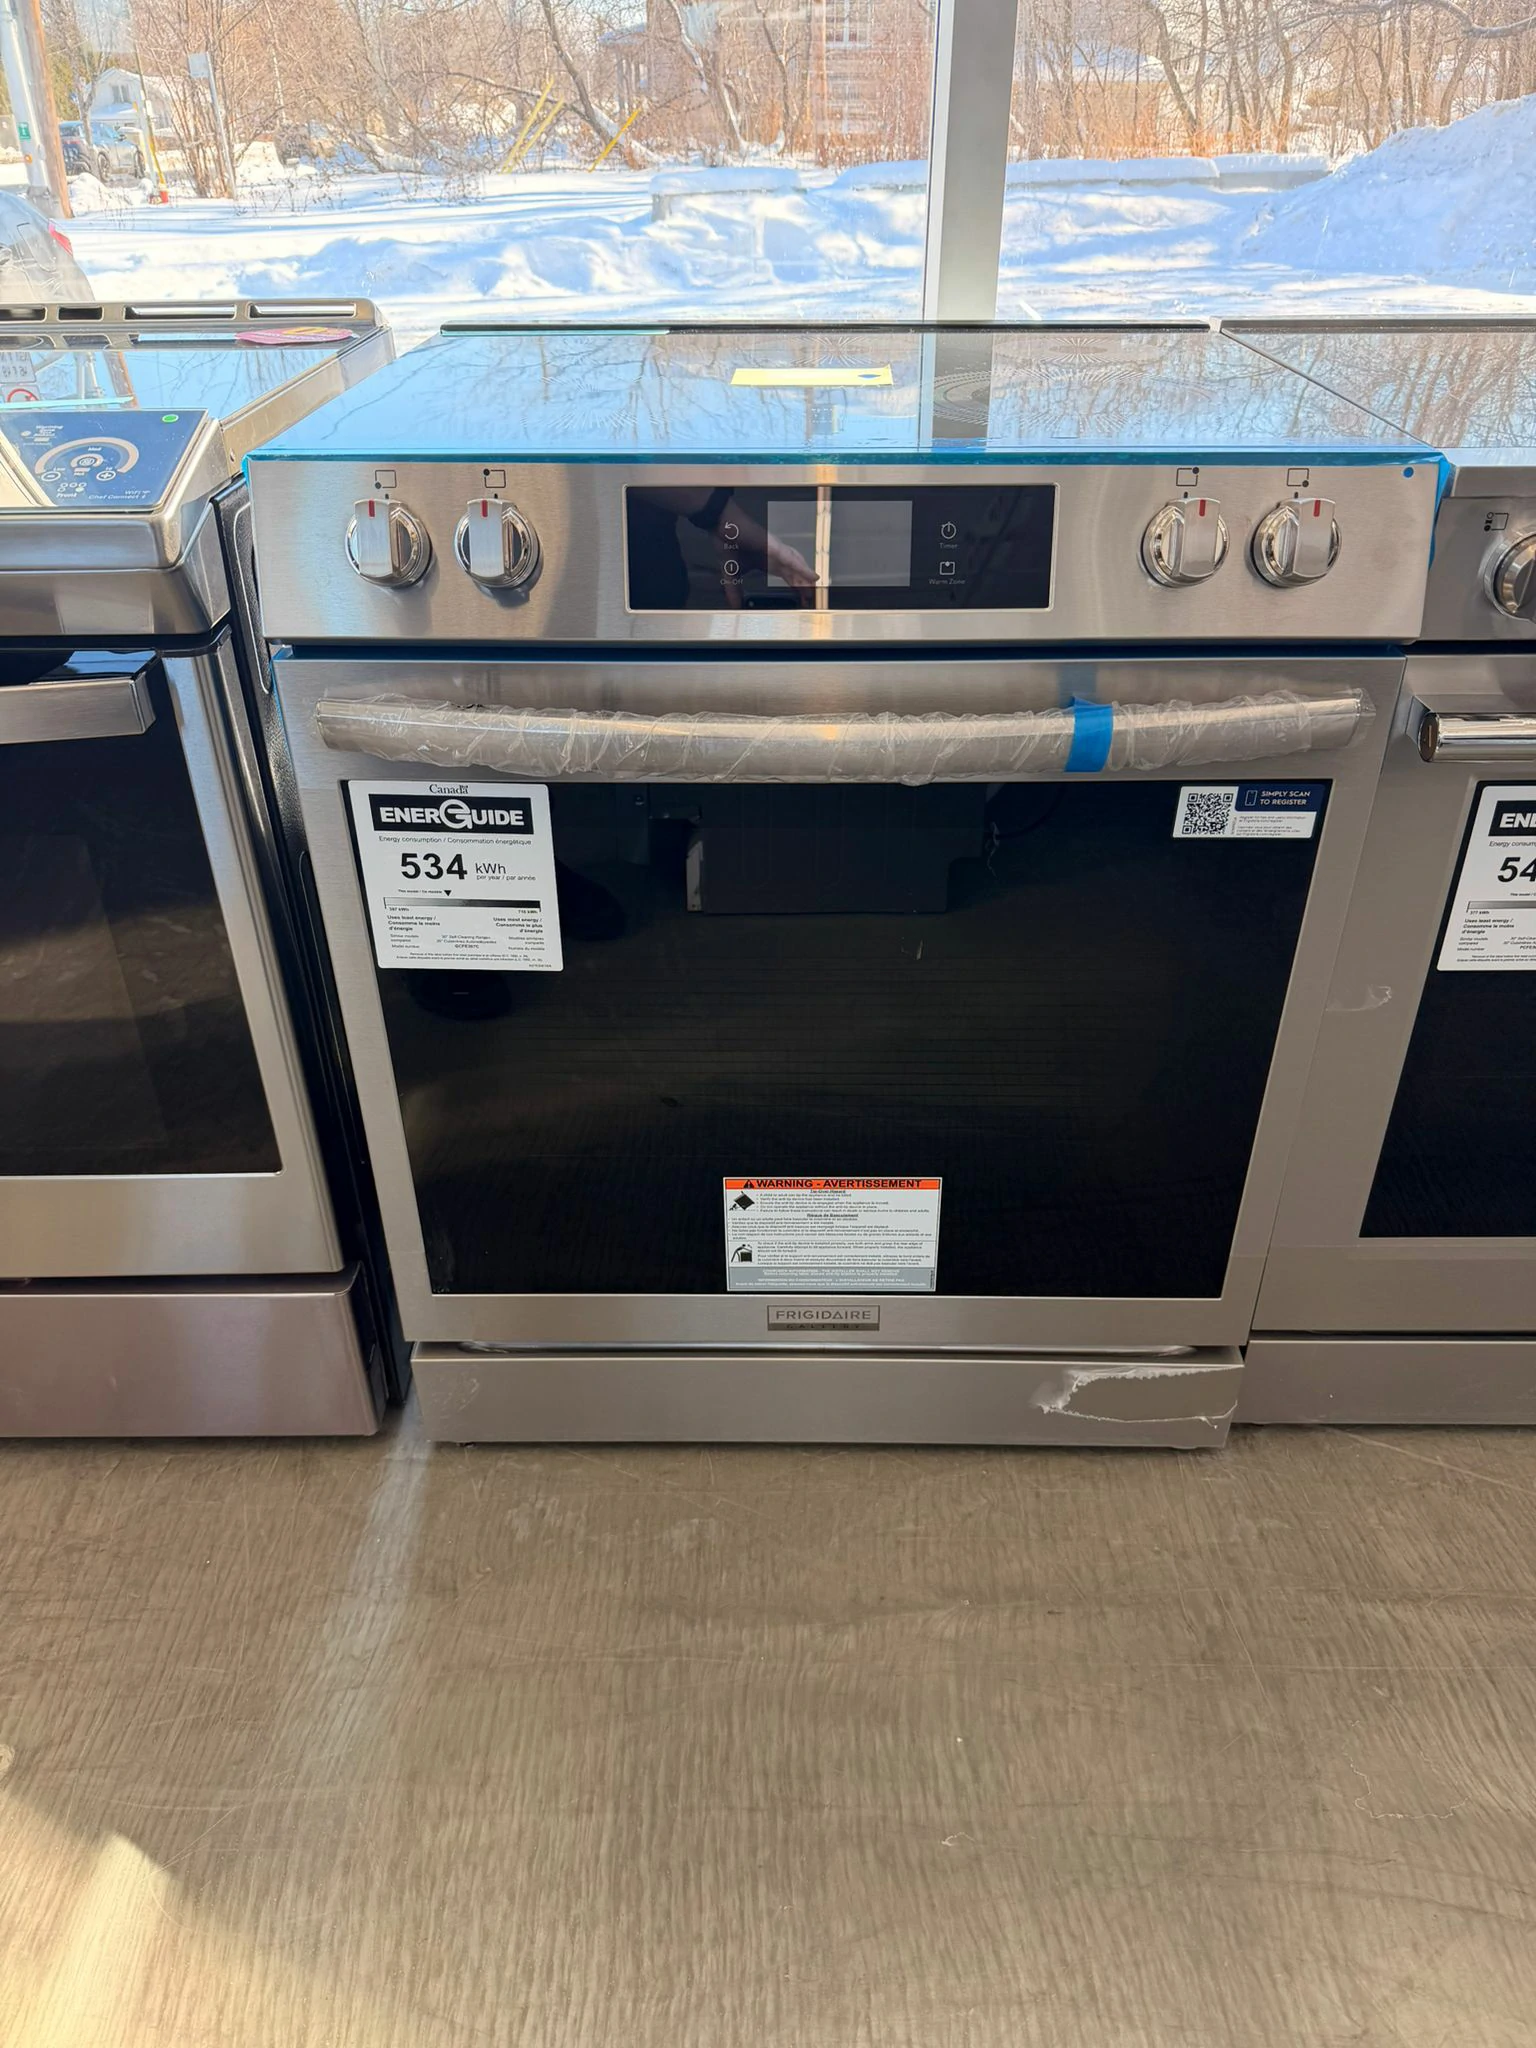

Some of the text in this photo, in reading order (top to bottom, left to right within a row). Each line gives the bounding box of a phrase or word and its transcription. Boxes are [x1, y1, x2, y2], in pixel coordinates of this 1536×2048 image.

[429, 784, 469, 795] Canada
[379, 836, 400, 844] Energy
[402, 836, 442, 844] consumption
[401, 853, 468, 880] 534
[475, 863, 506, 874] kWh
[756, 1180, 813, 1188] WARNING
[823, 1180, 921, 1188] AVERTISSEMENT
[776, 1310, 871, 1320] FRIGIDAIRE
